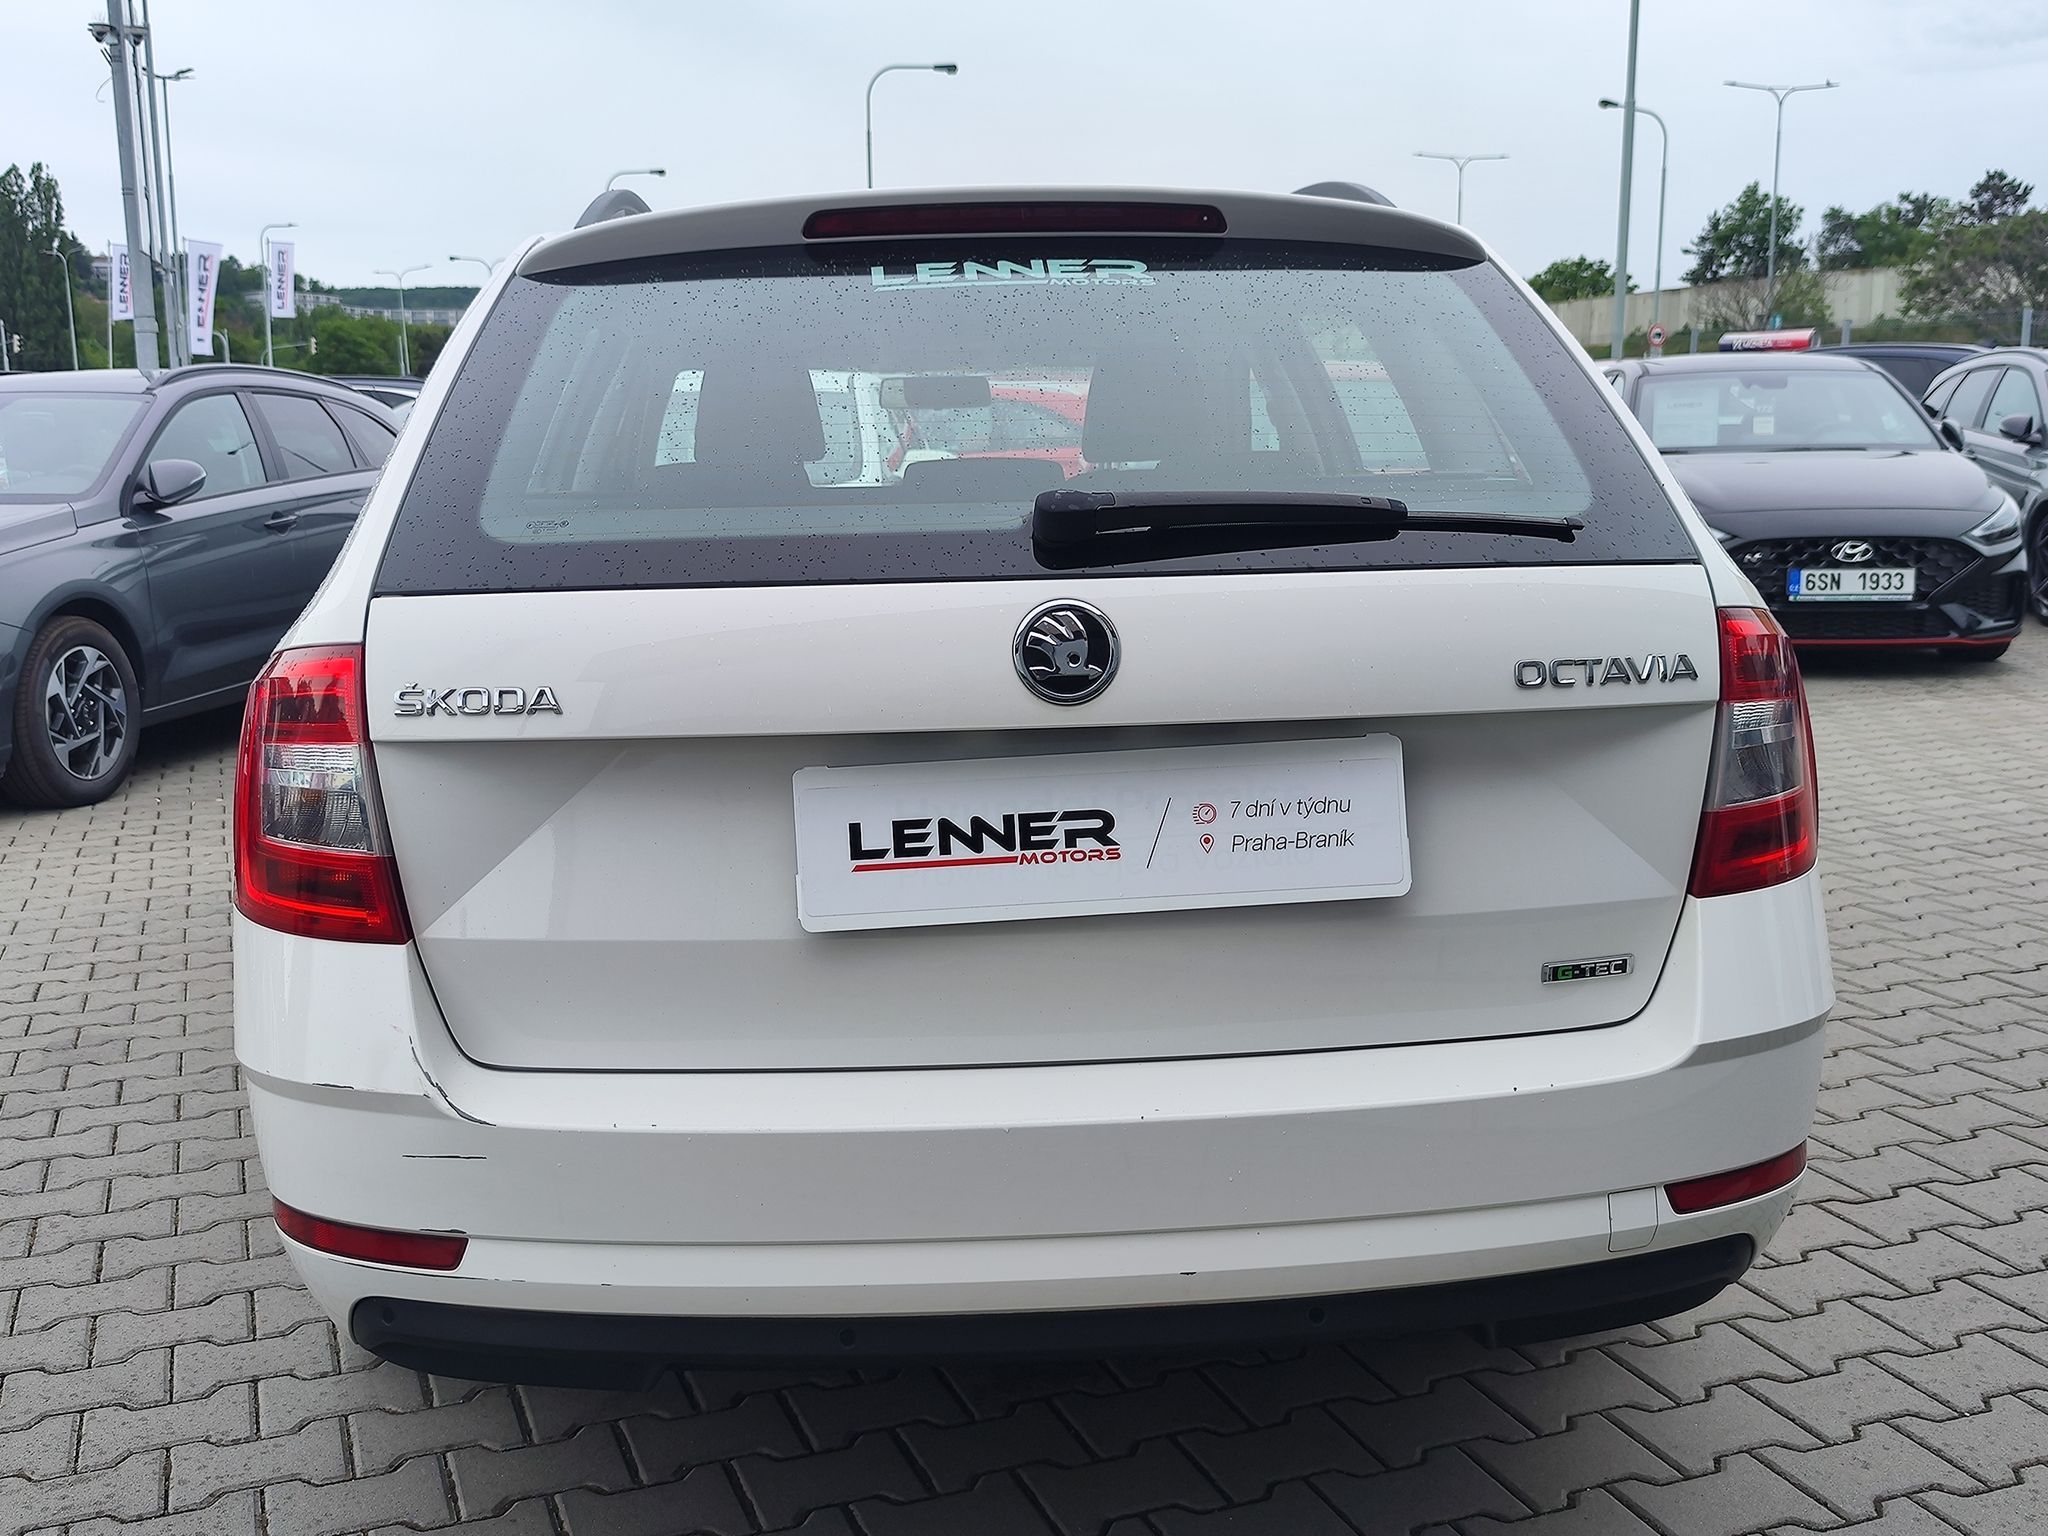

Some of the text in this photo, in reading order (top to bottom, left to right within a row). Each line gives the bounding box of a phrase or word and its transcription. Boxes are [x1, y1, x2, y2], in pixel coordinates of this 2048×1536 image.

[871, 259, 1148, 286] LENNER
[1050, 277, 1156, 286] MOTORS
[1805, 572, 1905, 591] 6SN 1933
[1514, 652, 1699, 689] OCTAVIA
[394, 682, 563, 717] ŠKODA
[1230, 796, 1351, 819] 7 dní v týdnu
[849, 809, 1121, 861] LENNER
[1231, 829, 1356, 853] Praha-Braník
[1018, 847, 1122, 866] MOTORS
[1557, 960, 1623, 980] G-TEC
